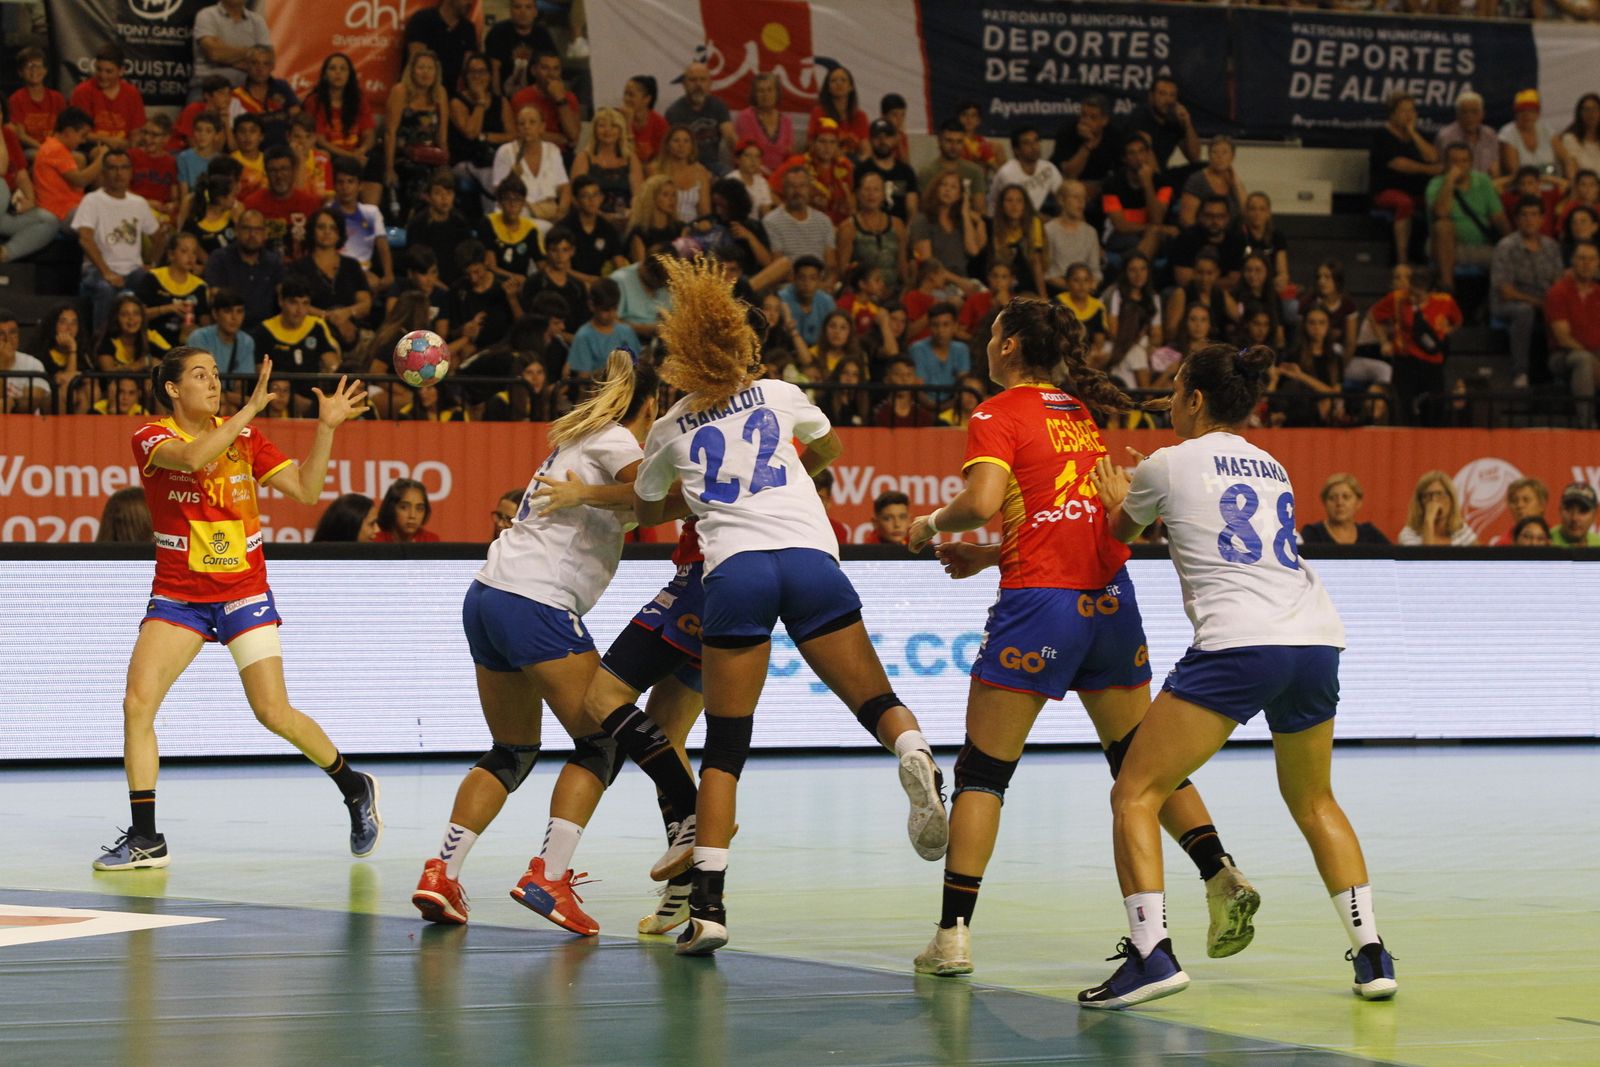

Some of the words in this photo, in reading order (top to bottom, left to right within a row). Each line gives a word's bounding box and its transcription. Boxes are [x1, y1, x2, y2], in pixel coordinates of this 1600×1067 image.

[117, 24, 149, 36] TONY
[982, 9, 1067, 25] PATRONATO
[1070, 14, 1146, 28] MUNICIPAL
[1150, 16, 1169, 28] DE
[982, 24, 1171, 59] DEPORTES
[1291, 23, 1374, 40] PATRONATO
[1377, 28, 1449, 43] MUNICIPAL
[1453, 33, 1472, 44] DE
[1289, 37, 1476, 75] DEPORTES
[985, 57, 1030, 82] DE
[1288, 71, 1335, 99] DE
[990, 97, 1082, 119] Ayuntamie
[689, 407, 787, 504] 22
[168, 490, 200, 503] AVIS
[203, 477, 226, 508] 37
[1217, 483, 1300, 571] 88
[202, 554, 239, 565] Correos
[1076, 593, 1120, 618] GO
[999, 646, 1046, 674] GO
[1040, 646, 1058, 660] fit
